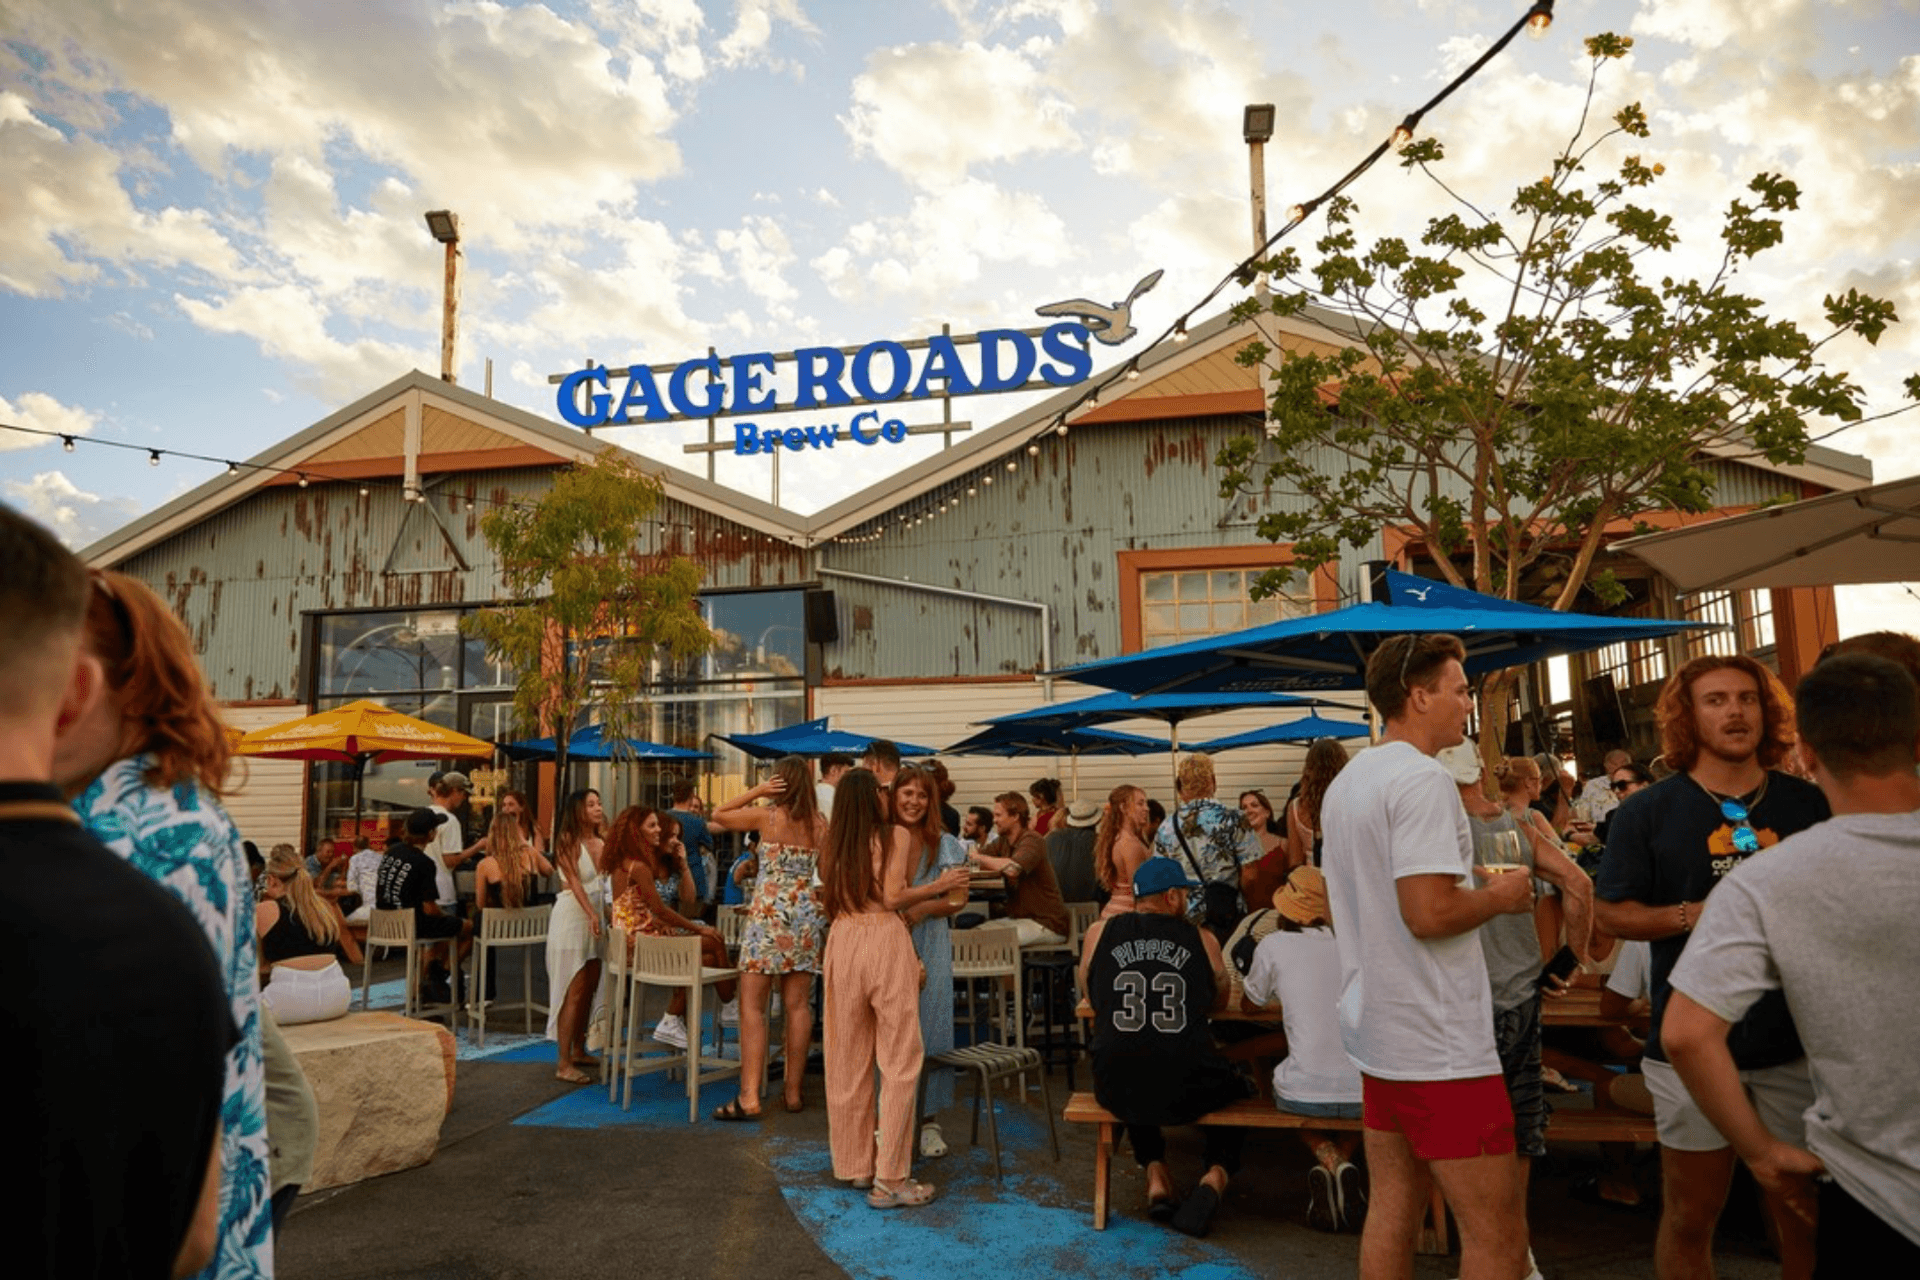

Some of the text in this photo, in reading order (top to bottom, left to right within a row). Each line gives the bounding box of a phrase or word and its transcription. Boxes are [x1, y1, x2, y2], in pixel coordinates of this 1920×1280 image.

[556, 322, 1094, 428] GAGE ROADS
[734, 409, 908, 456] Brew Co
[1111, 939, 1191, 970] PIPPEN
[1113, 970, 1187, 1033] 33
